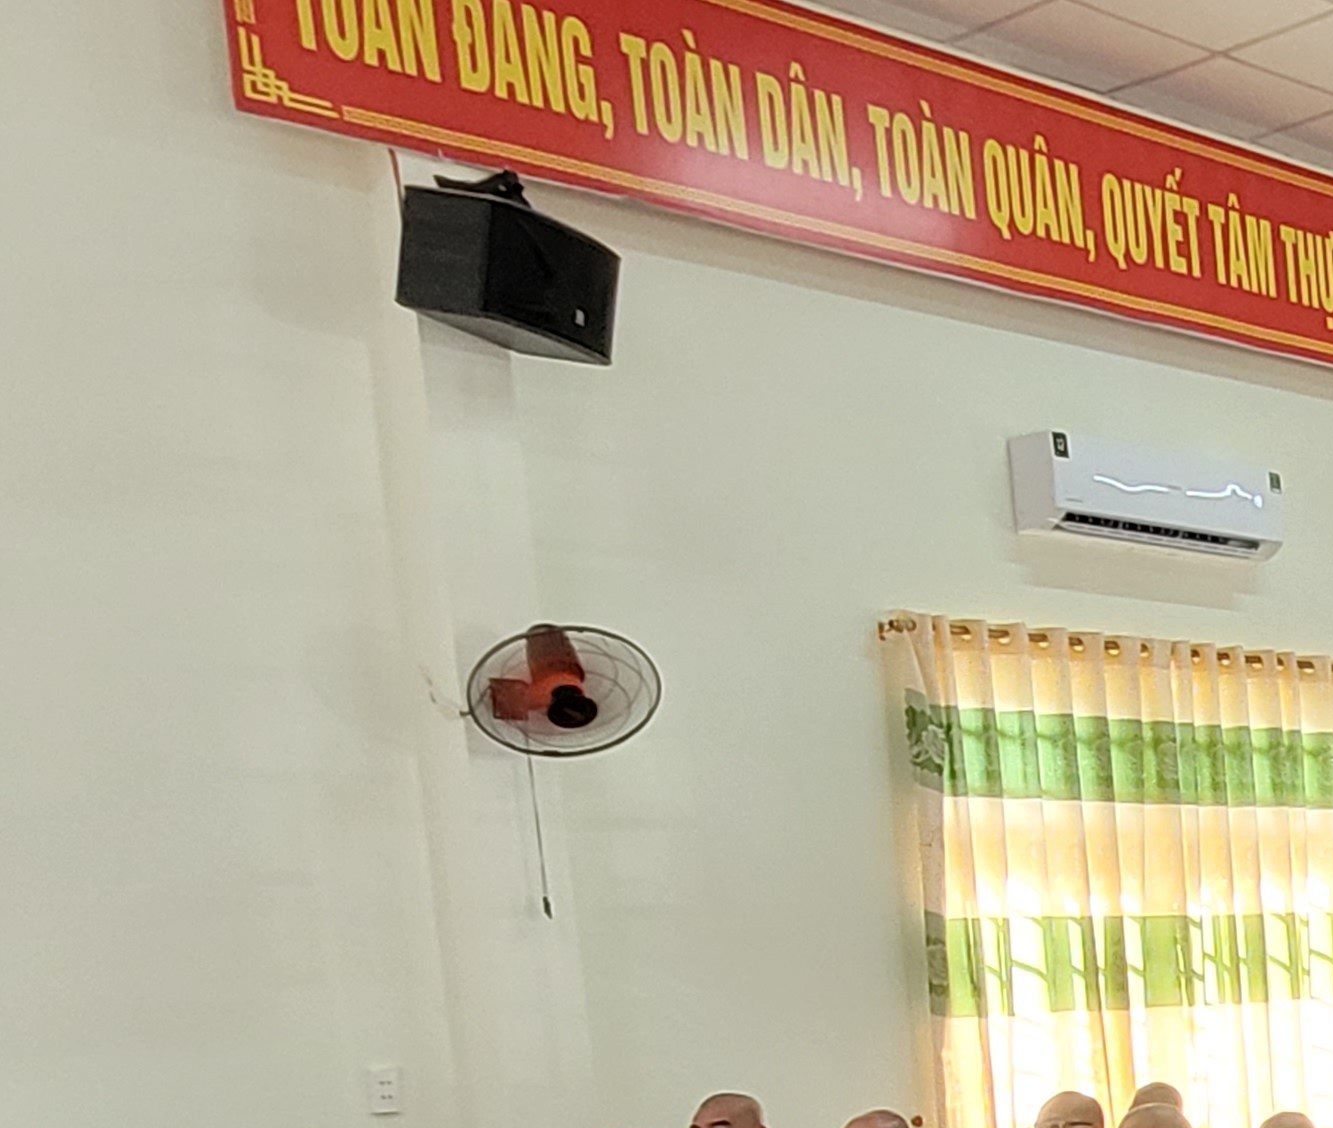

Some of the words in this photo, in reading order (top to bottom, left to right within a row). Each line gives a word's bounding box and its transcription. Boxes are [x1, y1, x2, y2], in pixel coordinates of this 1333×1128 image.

[619, 29, 749, 160] TOÀN
[755, 61, 862, 201] DÂN,
[867, 100, 976, 220] TOÀN
[983, 134, 1096, 263] QUÂN,
[1102, 167, 1201, 278] QUYẾT
[1207, 192, 1277, 299] TÂM
